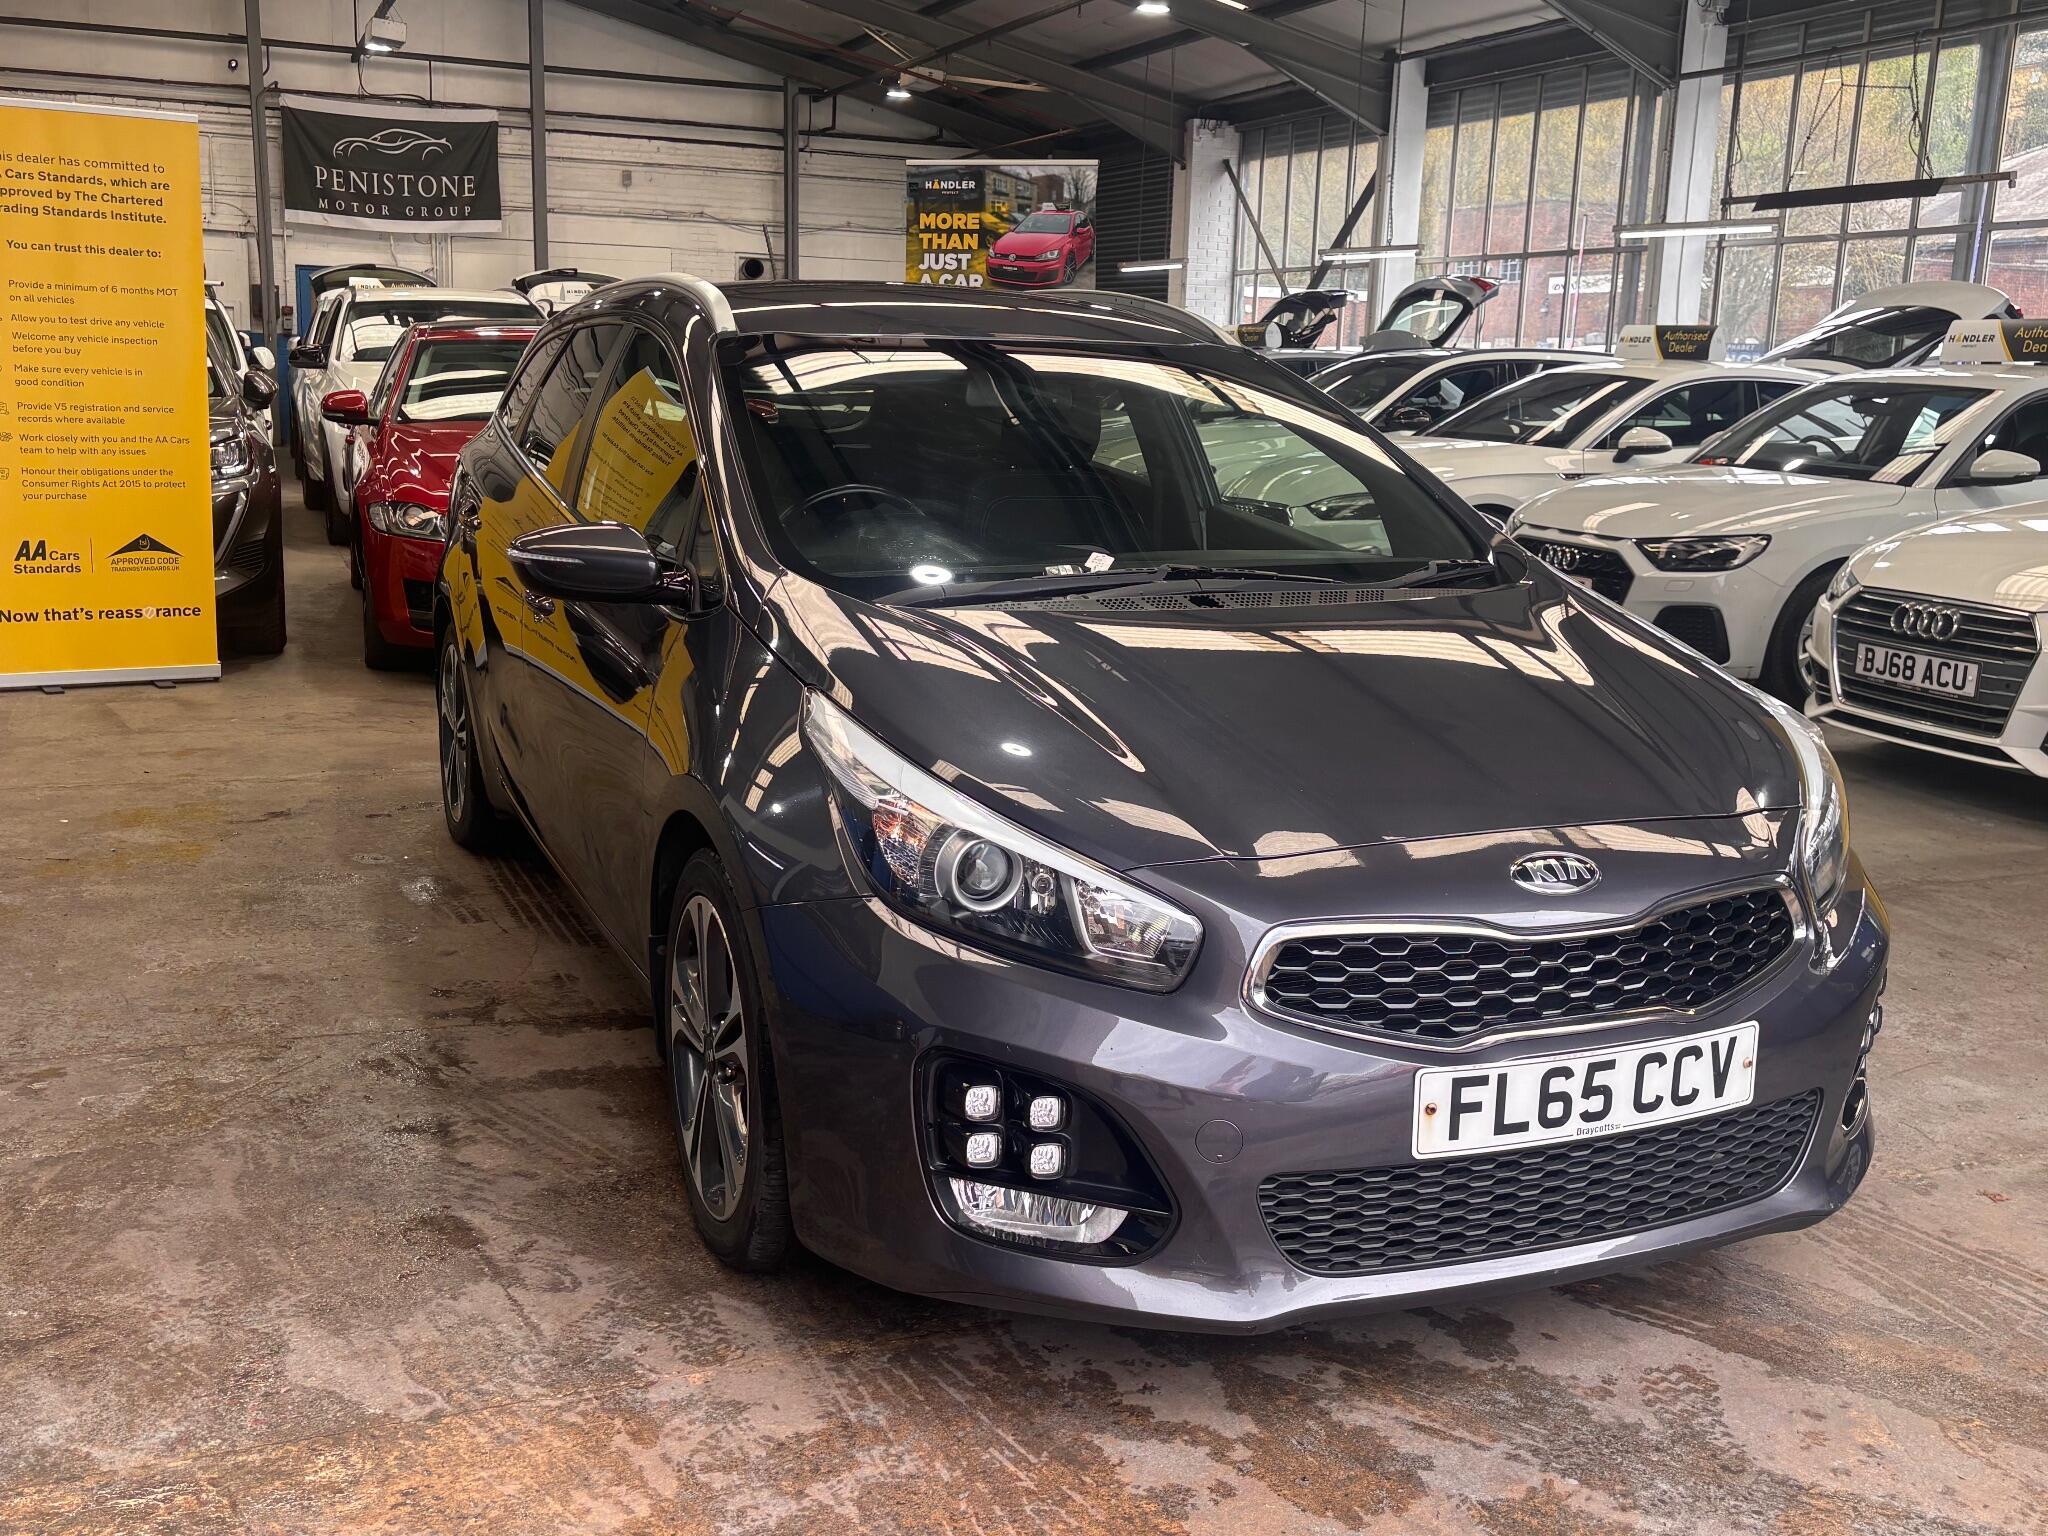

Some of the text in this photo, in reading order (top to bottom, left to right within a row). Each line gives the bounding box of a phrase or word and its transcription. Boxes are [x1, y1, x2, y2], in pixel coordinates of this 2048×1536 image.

[17, 153, 55, 164] dealer
[58, 155, 81, 167] has
[84, 160, 150, 172] committed
[153, 163, 165, 174] to
[4, 168, 170, 190] Cars Standards, which are
[314, 165, 476, 198] PENISTONE
[56, 189, 72, 202] by
[74, 190, 98, 202] The
[100, 192, 164, 206] Chartered
[42, 205, 108, 220] Standards
[110, 210, 167, 224] Institute.
[318, 197, 472, 217] MOTOR GROUP
[920, 212, 980, 230] MORE
[918, 232, 979, 250] THAN
[6, 240, 162, 258] You can trust this dealer to:
[918, 252, 972, 271] JUST
[8, 280, 45, 290] Provide
[54, 283, 98, 292] minimum
[100, 284, 110, 293] of
[111, 286, 118, 294] 6
[120, 287, 156, 296] months
[156, 288, 179, 296] MOT
[938, 273, 984, 288] CAR
[9, 294, 76, 304] on all vehicles
[10, 314, 166, 328] Allow you to test drive any vehicle
[11, 331, 158, 346] Welcome any vehicle inspection
[1663, 330, 1710, 342] Authorised
[12, 344, 82, 356] before you buy
[1668, 342, 1698, 353] Dealer
[14, 364, 40, 373] Make
[64, 367, 89, 376] every
[90, 367, 124, 376] vehicle
[125, 368, 133, 376] is
[134, 368, 144, 376] in
[14, 378, 85, 388] good condition
[17, 402, 176, 414] Provide V5 registration and service
[18, 414, 126, 425] records where available
[18, 434, 191, 445] Work closely with you and the AA Cars
[20, 446, 148, 457] team to help with any issues
[21, 466, 174, 477] Honour their obligations under the
[22, 479, 186, 489] Consumer Rights Act 2015 to protect
[22, 492, 88, 502] your purchase
[14, 540, 80, 562] AA Cars
[14, 562, 82, 574] Standards
[110, 556, 180, 566] APPROVED CODE
[0, 608, 40, 623] Now
[44, 606, 94, 622] that's
[1862, 646, 1970, 692] BJ68 ACU
[1525, 858, 1592, 884] KIA
[1448, 1035, 1739, 1141] FL65 CCV
[1576, 1122, 1615, 1136] Draycotts
